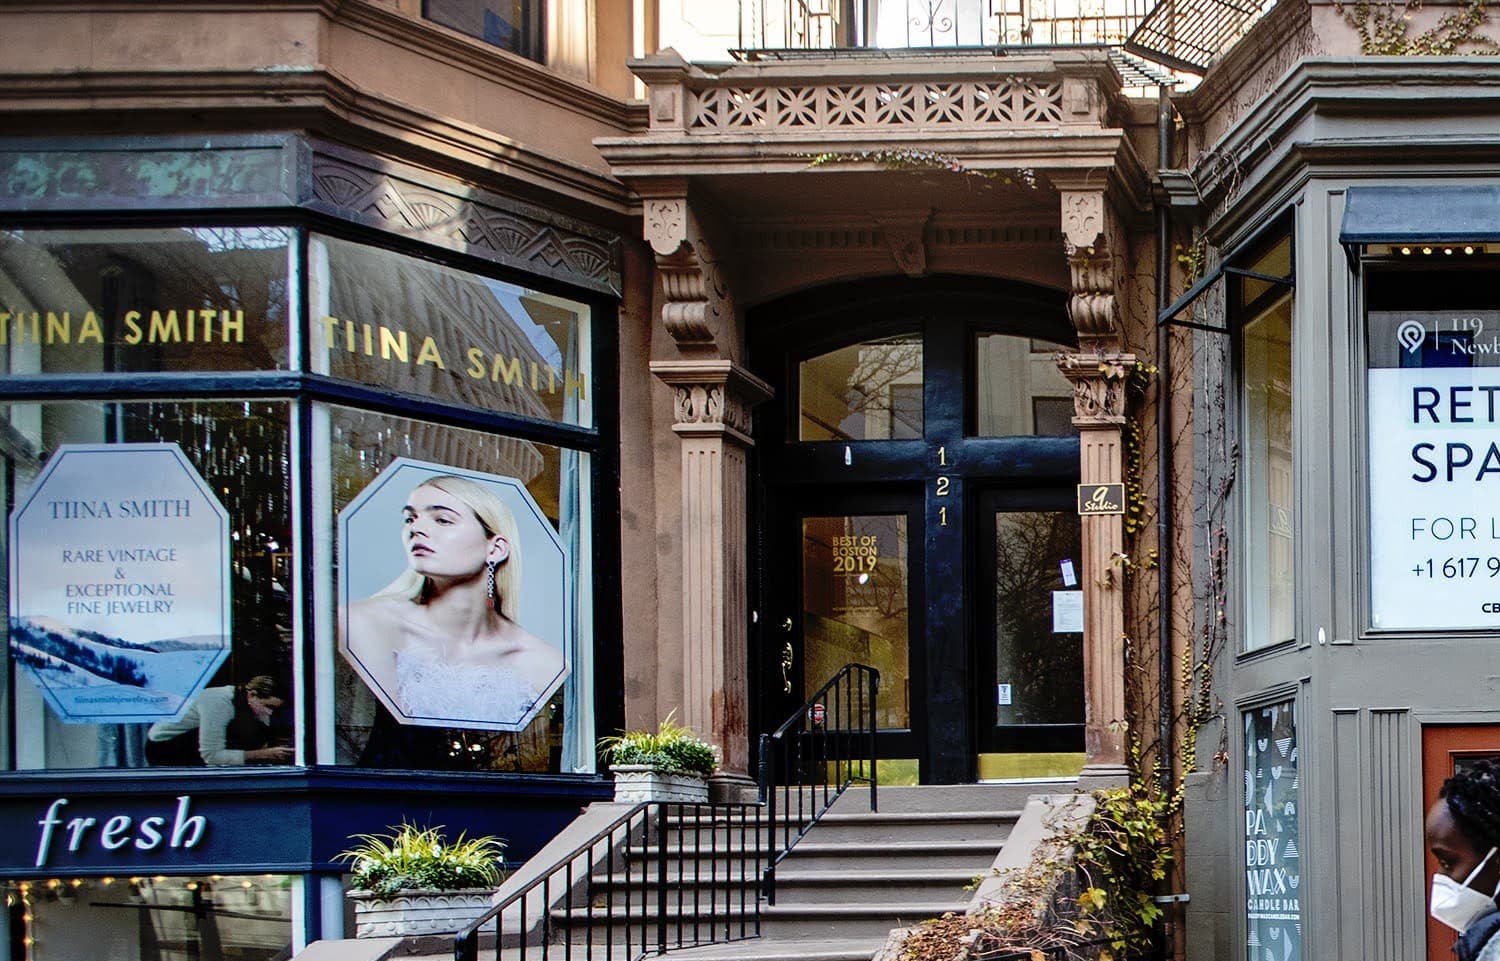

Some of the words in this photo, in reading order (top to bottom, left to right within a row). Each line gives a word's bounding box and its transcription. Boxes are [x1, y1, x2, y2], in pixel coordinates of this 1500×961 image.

[0, 310, 104, 345] TIINA
[124, 310, 244, 345] SMITH
[1451, 318, 1483, 337] 119
[321, 316, 445, 370] TIINA
[467, 347, 586, 401] SMITH
[936, 446, 949, 526] 121
[48, 501, 112, 519] TIINA
[119, 500, 191, 518] SMITH
[1411, 518, 1477, 540] FOR
[832, 536, 857, 546] BEST
[860, 536, 877, 546] OF
[63, 550, 104, 563] RARE
[107, 549, 177, 562] VINTAGE
[832, 547, 877, 557] BOSTON
[114, 567, 126, 580] &
[833, 557, 877, 572] 2019
[1412, 558, 1433, 578] +1
[1442, 557, 1479, 578] 617
[65, 584, 175, 597] EXCEPTIONAL
[67, 602, 100, 614] FINE
[106, 600, 174, 615] JEWELRY
[36, 796, 208, 867] fresh
[1247, 868, 1286, 895] WAX
[1247, 899, 1281, 910] CANDLE
[1283, 899, 1300, 910] BAR
